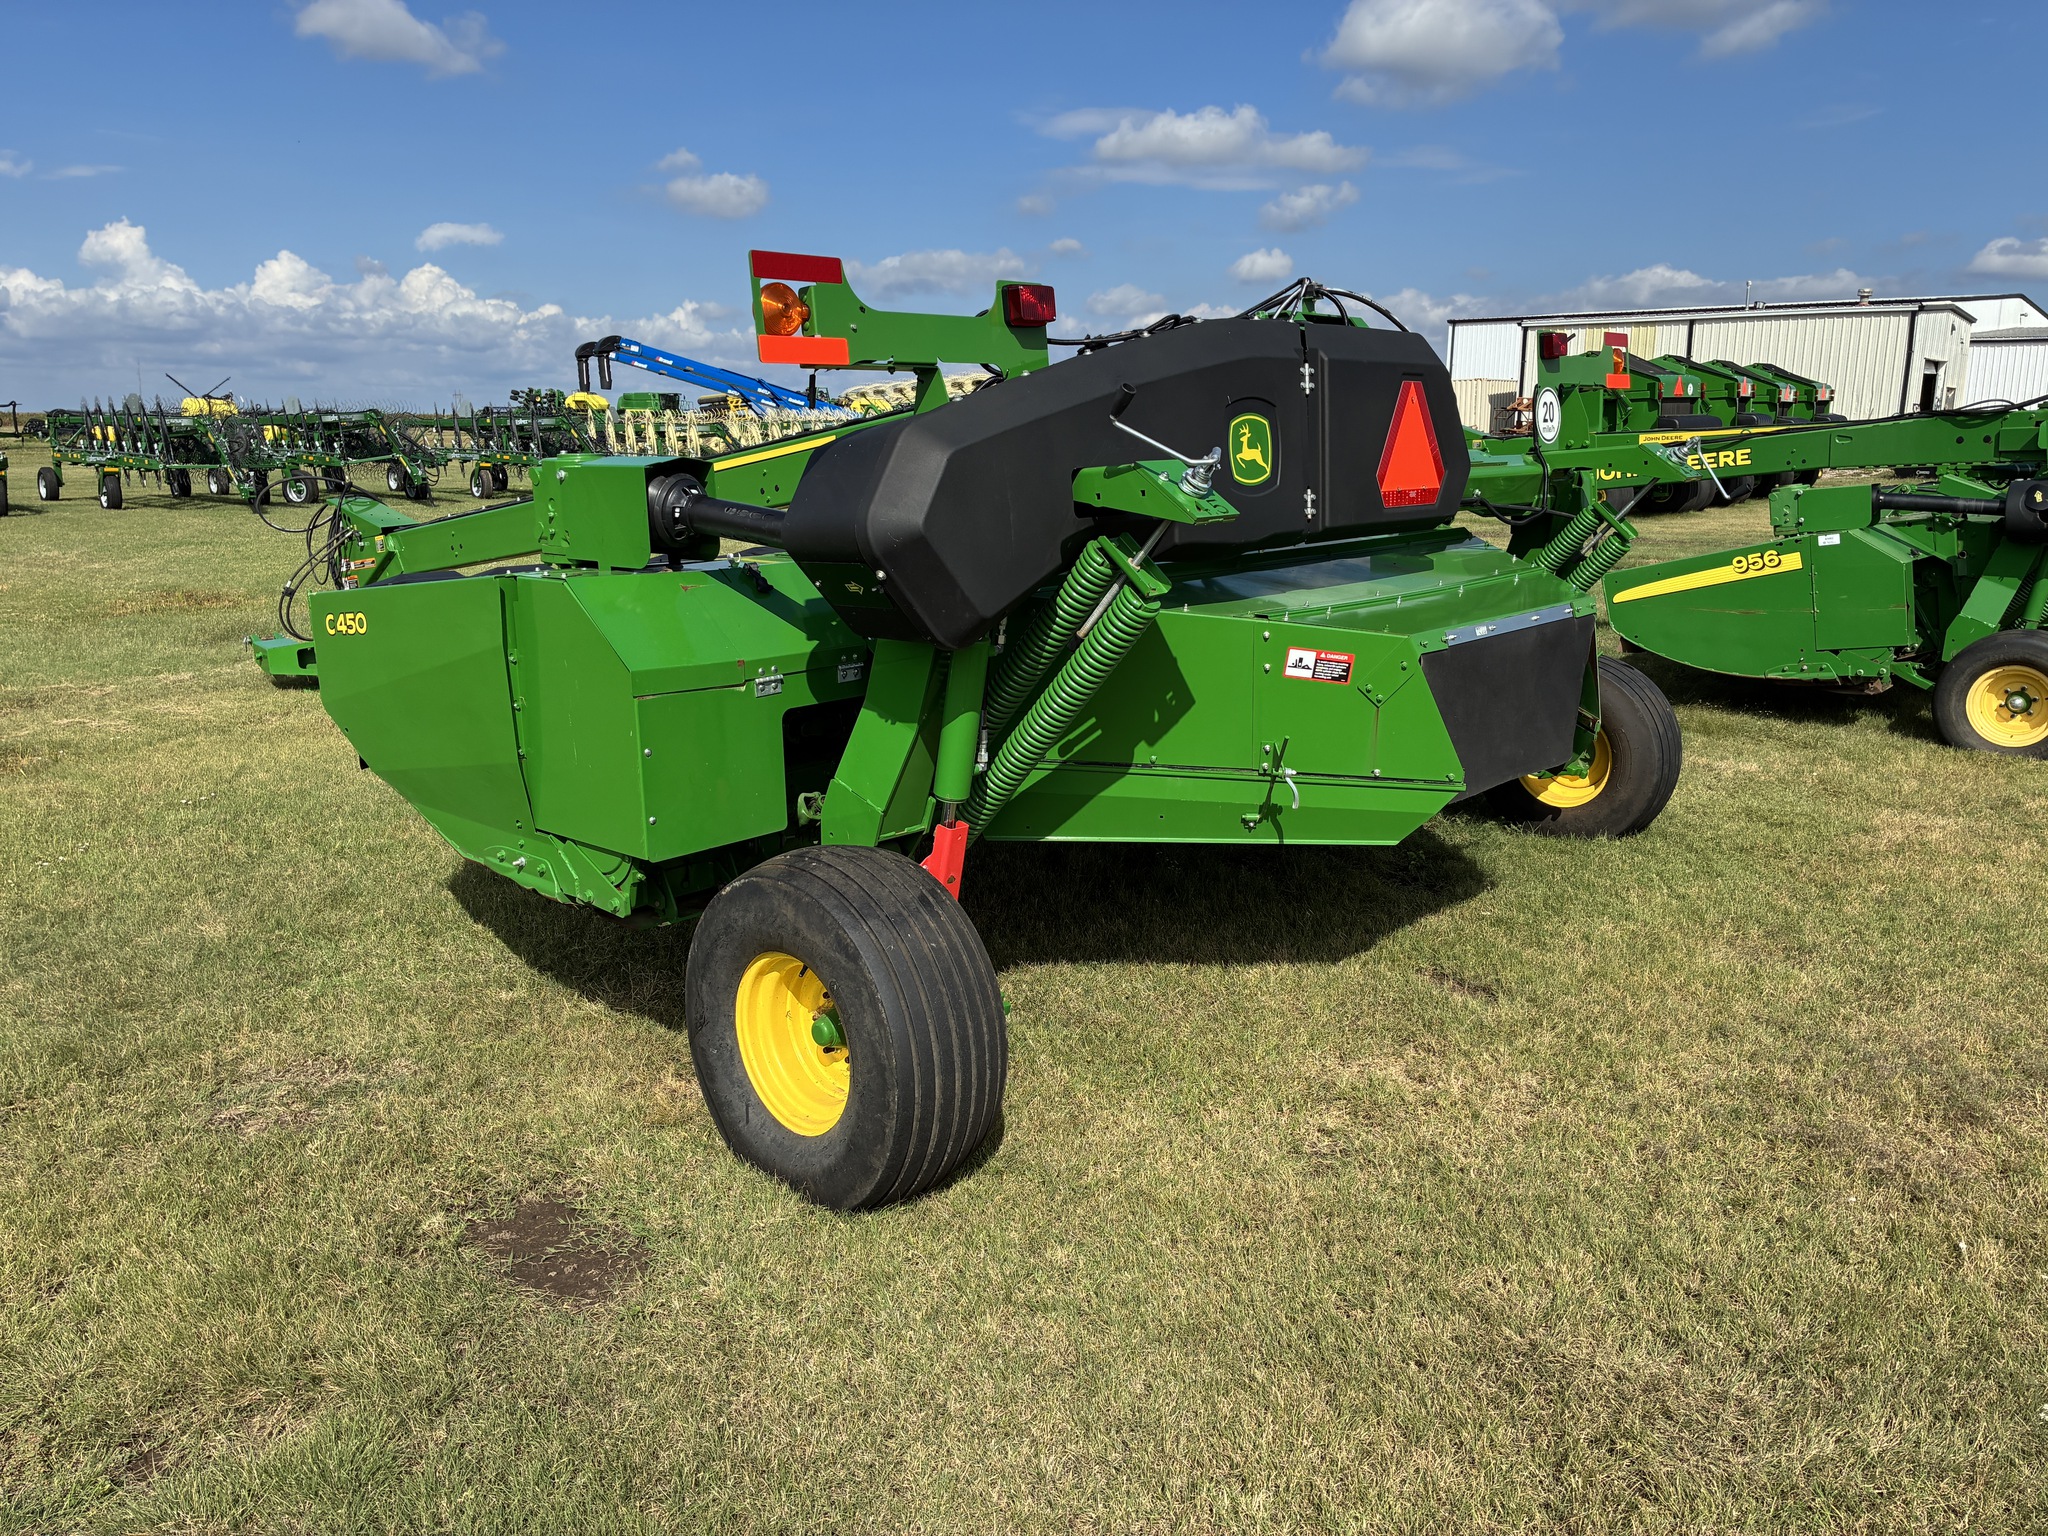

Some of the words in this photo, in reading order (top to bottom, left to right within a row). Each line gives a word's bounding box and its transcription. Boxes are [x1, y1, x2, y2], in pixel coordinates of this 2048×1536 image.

[1542, 401, 1554, 423] 20
[1686, 448, 1752, 470] EERE
[1732, 549, 1781, 574] 956
[1326, 653, 1348, 661] DANGER
